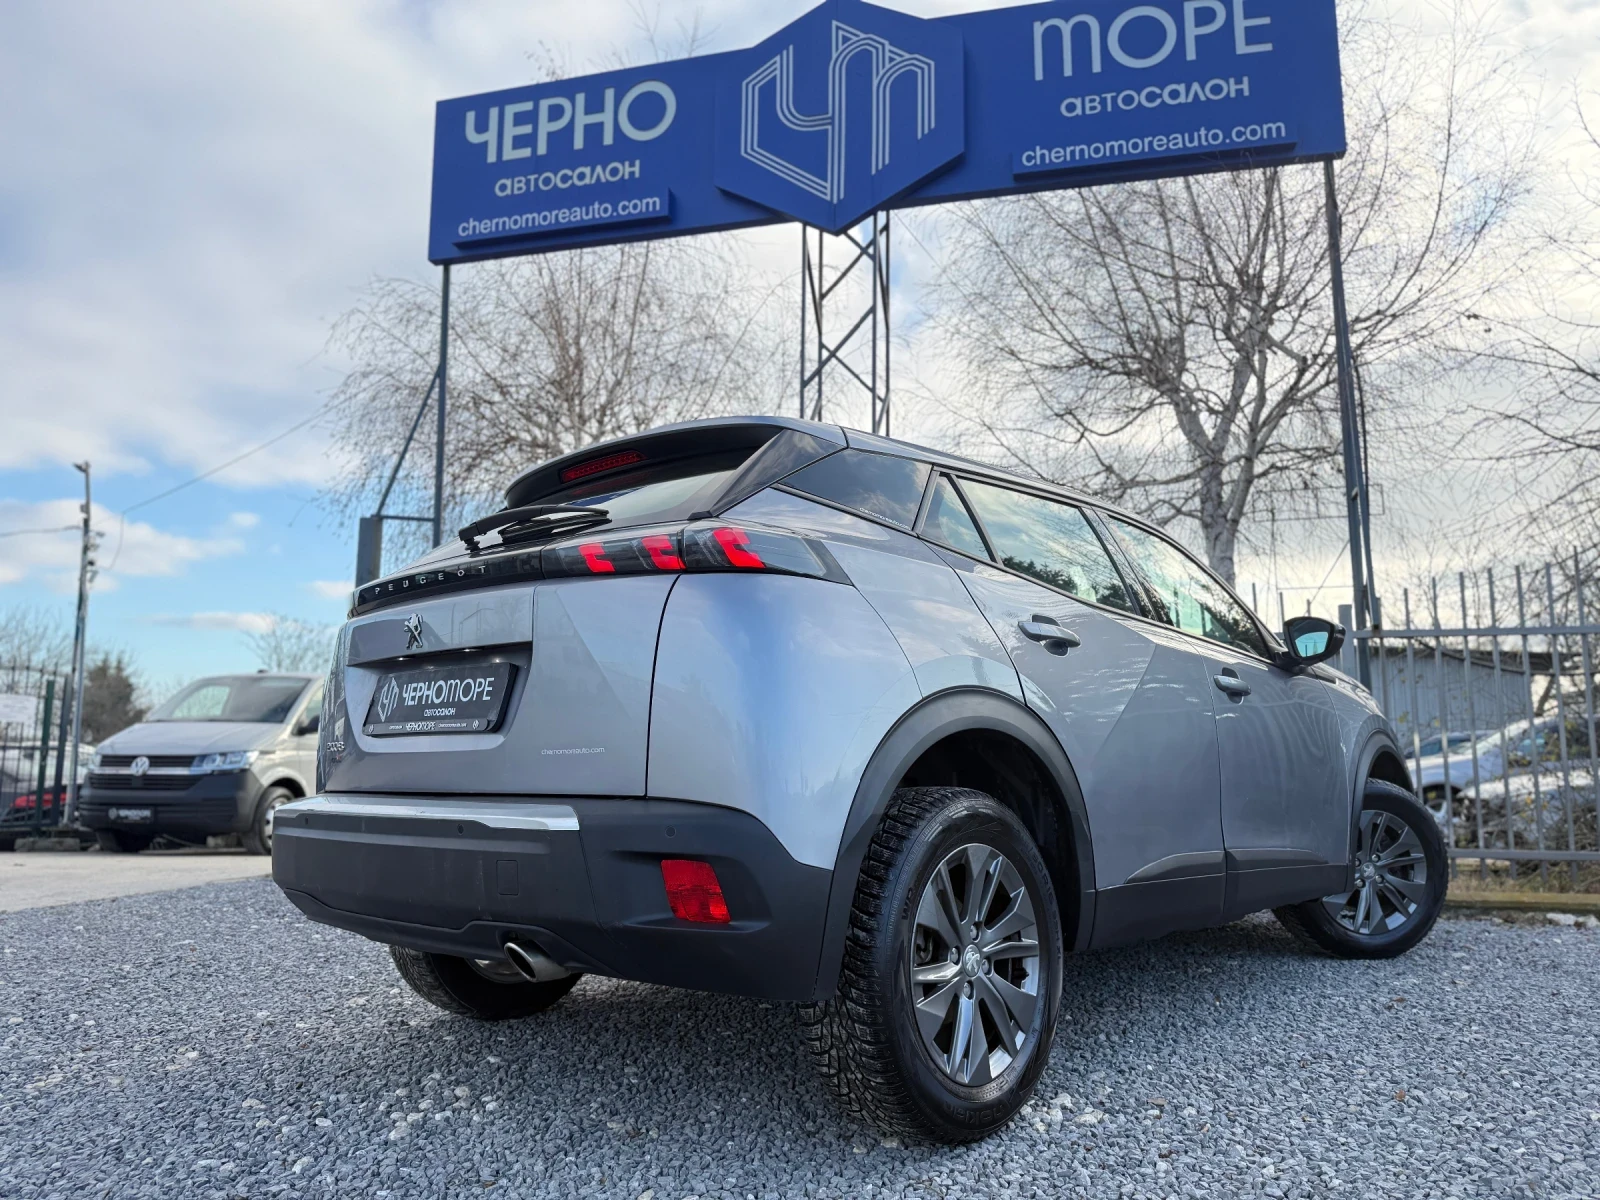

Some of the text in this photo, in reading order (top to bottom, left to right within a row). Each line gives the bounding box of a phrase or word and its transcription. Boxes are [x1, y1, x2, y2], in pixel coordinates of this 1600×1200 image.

[465, 80, 677, 163] ЧЕРНО
[1021, 121, 1286, 167] chernomoreauto.com
[458, 197, 661, 237] chernomoreauto.com
[374, 565, 487, 595] PEUGEOT
[402, 677, 495, 706] ЧЕРНОМОРЕ
